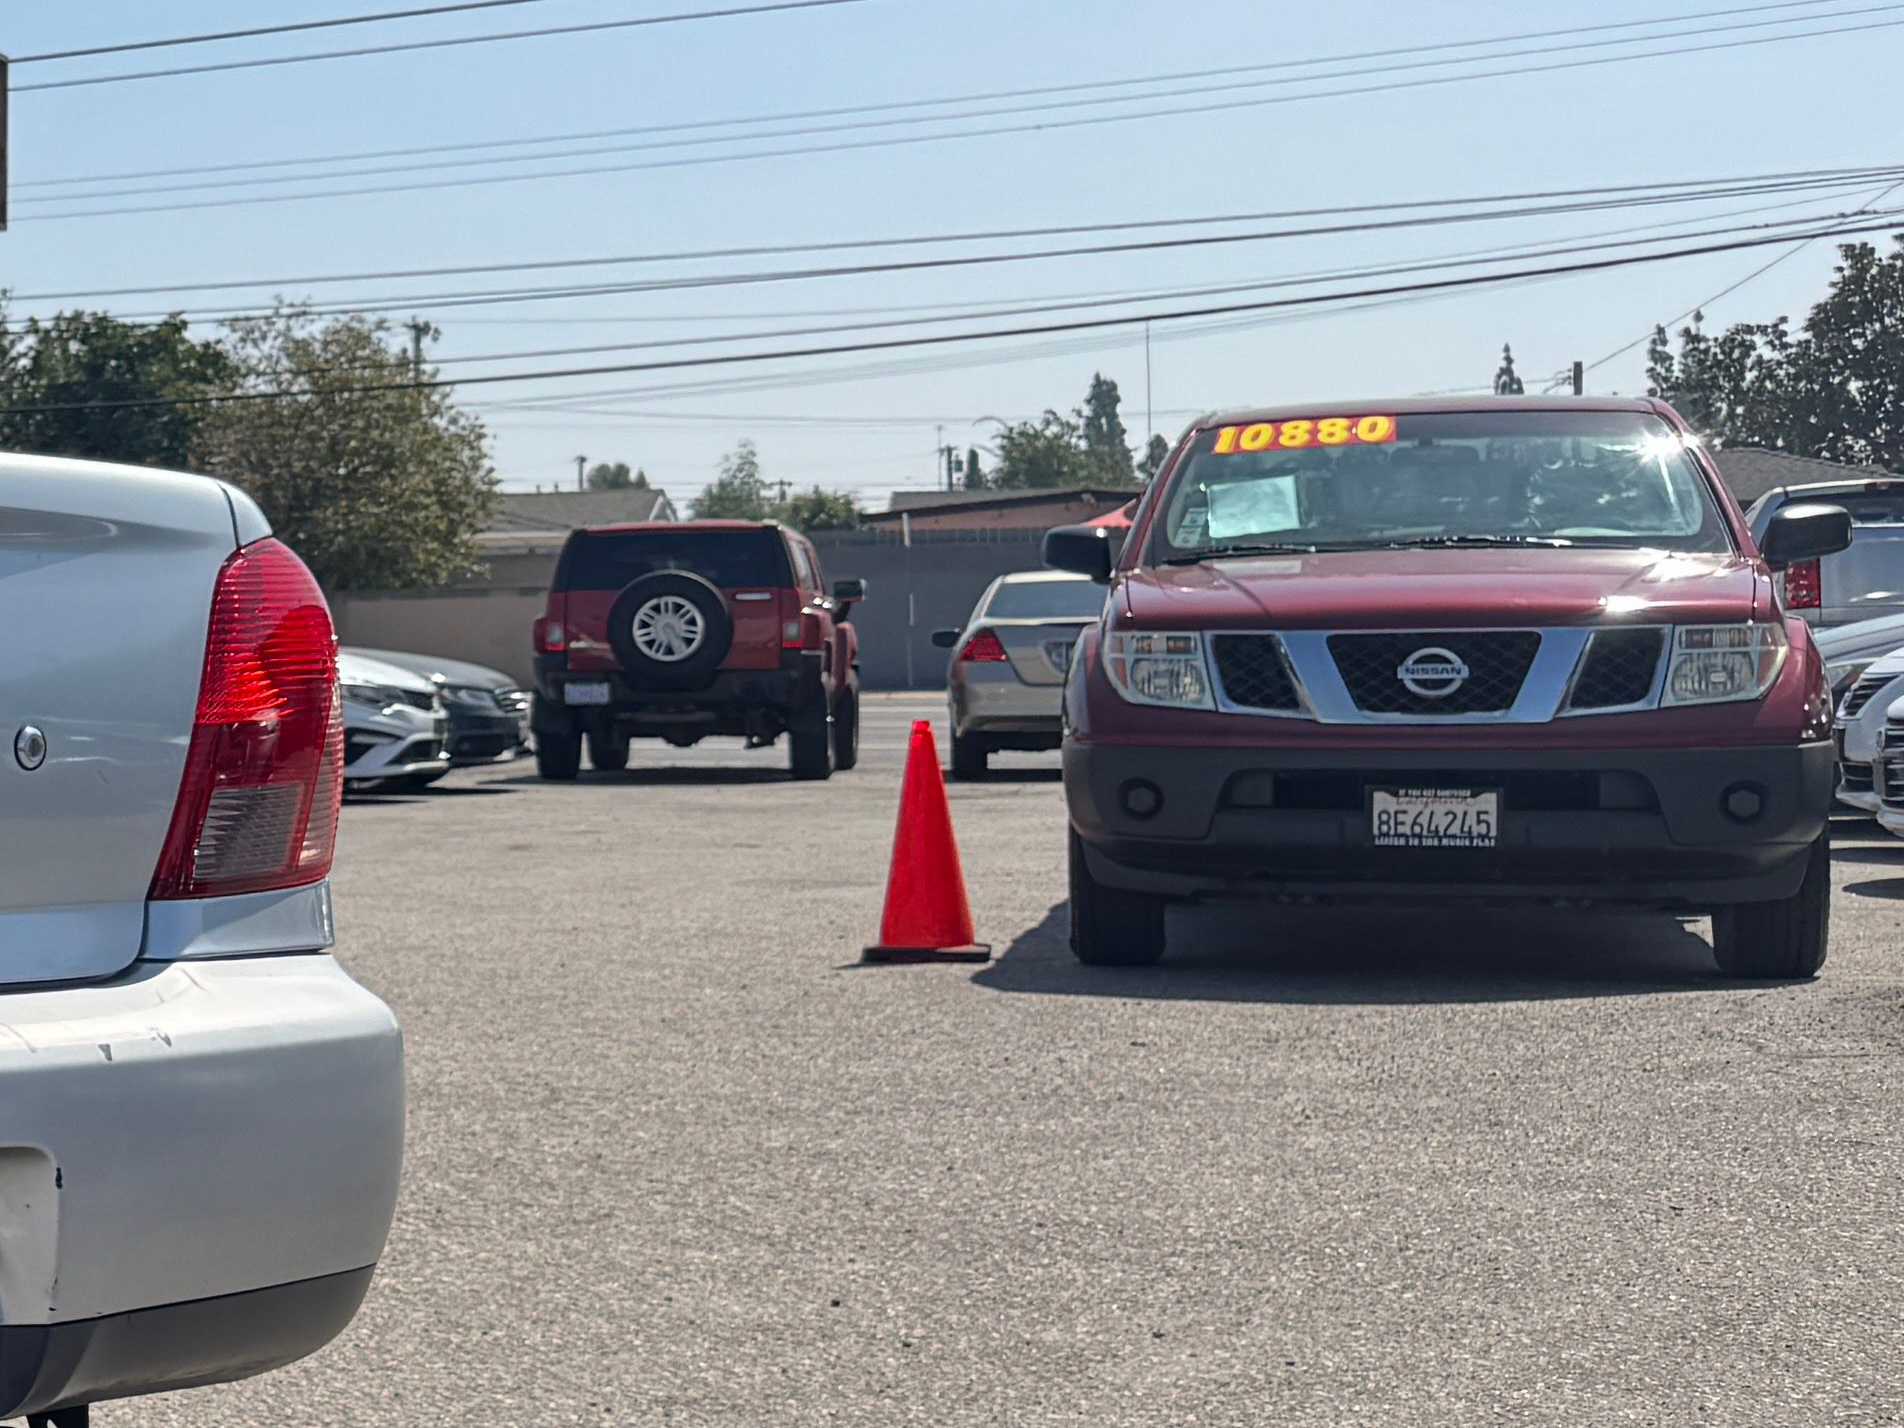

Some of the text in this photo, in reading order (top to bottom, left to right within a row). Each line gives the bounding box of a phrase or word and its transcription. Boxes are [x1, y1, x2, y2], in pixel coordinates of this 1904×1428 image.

[1213, 415, 1391, 454] 10880
[1404, 667, 1462, 676] NISSAN
[1377, 810, 1491, 838] 8E64245
